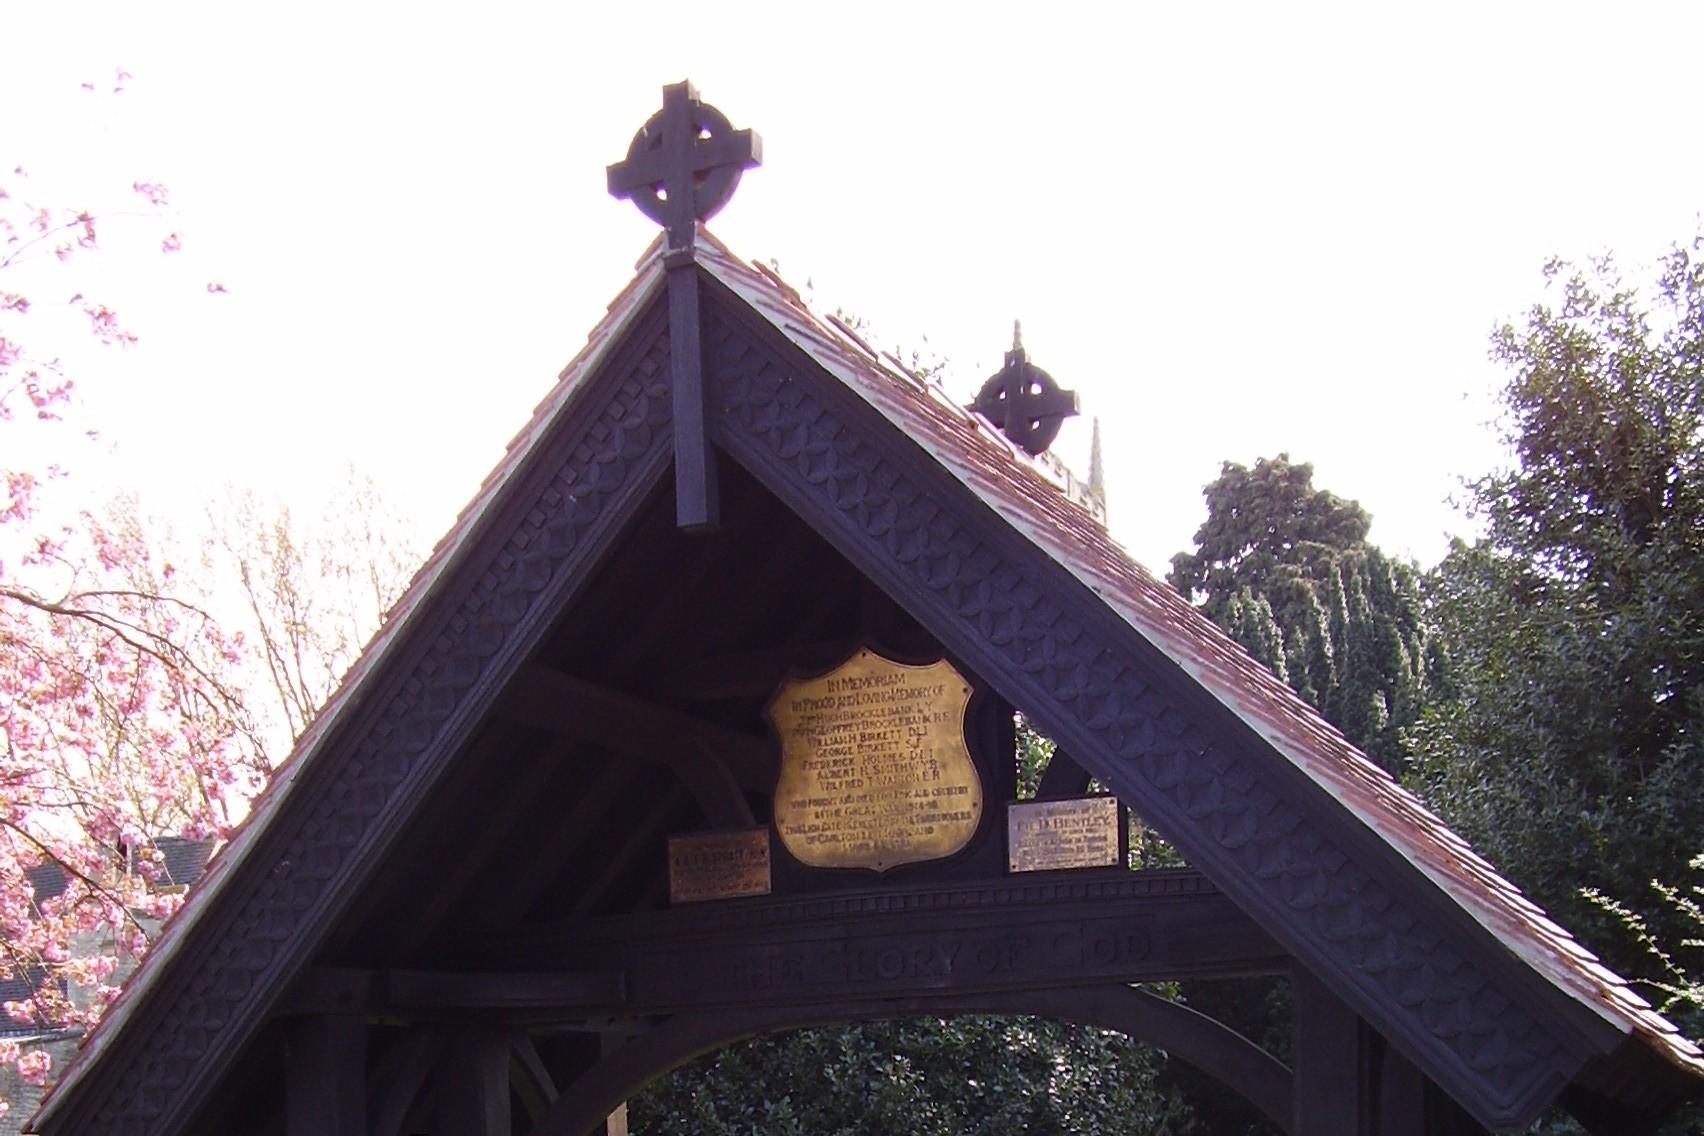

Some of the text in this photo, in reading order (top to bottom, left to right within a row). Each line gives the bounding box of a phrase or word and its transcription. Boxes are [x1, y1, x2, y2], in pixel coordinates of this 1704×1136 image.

[826, 673, 906, 693] IN MEMORIAM
[836, 694, 857, 709] AND
[856, 691, 889, 706] LOVING
[889, 686, 932, 703] MEMORY
[932, 684, 946, 695] OF
[859, 729, 903, 743] BIRKETT
[815, 744, 855, 758] GEORGE
[856, 740, 900, 754] BIRKETT
[801, 757, 856, 771] FREDERICK
[861, 751, 907, 766] HOLMES
[1053, 814, 1112, 830] BENTLEY
[820, 938, 964, 985] GLORY
[976, 934, 1032, 975] OF
[1050, 924, 1154, 970] GOD
